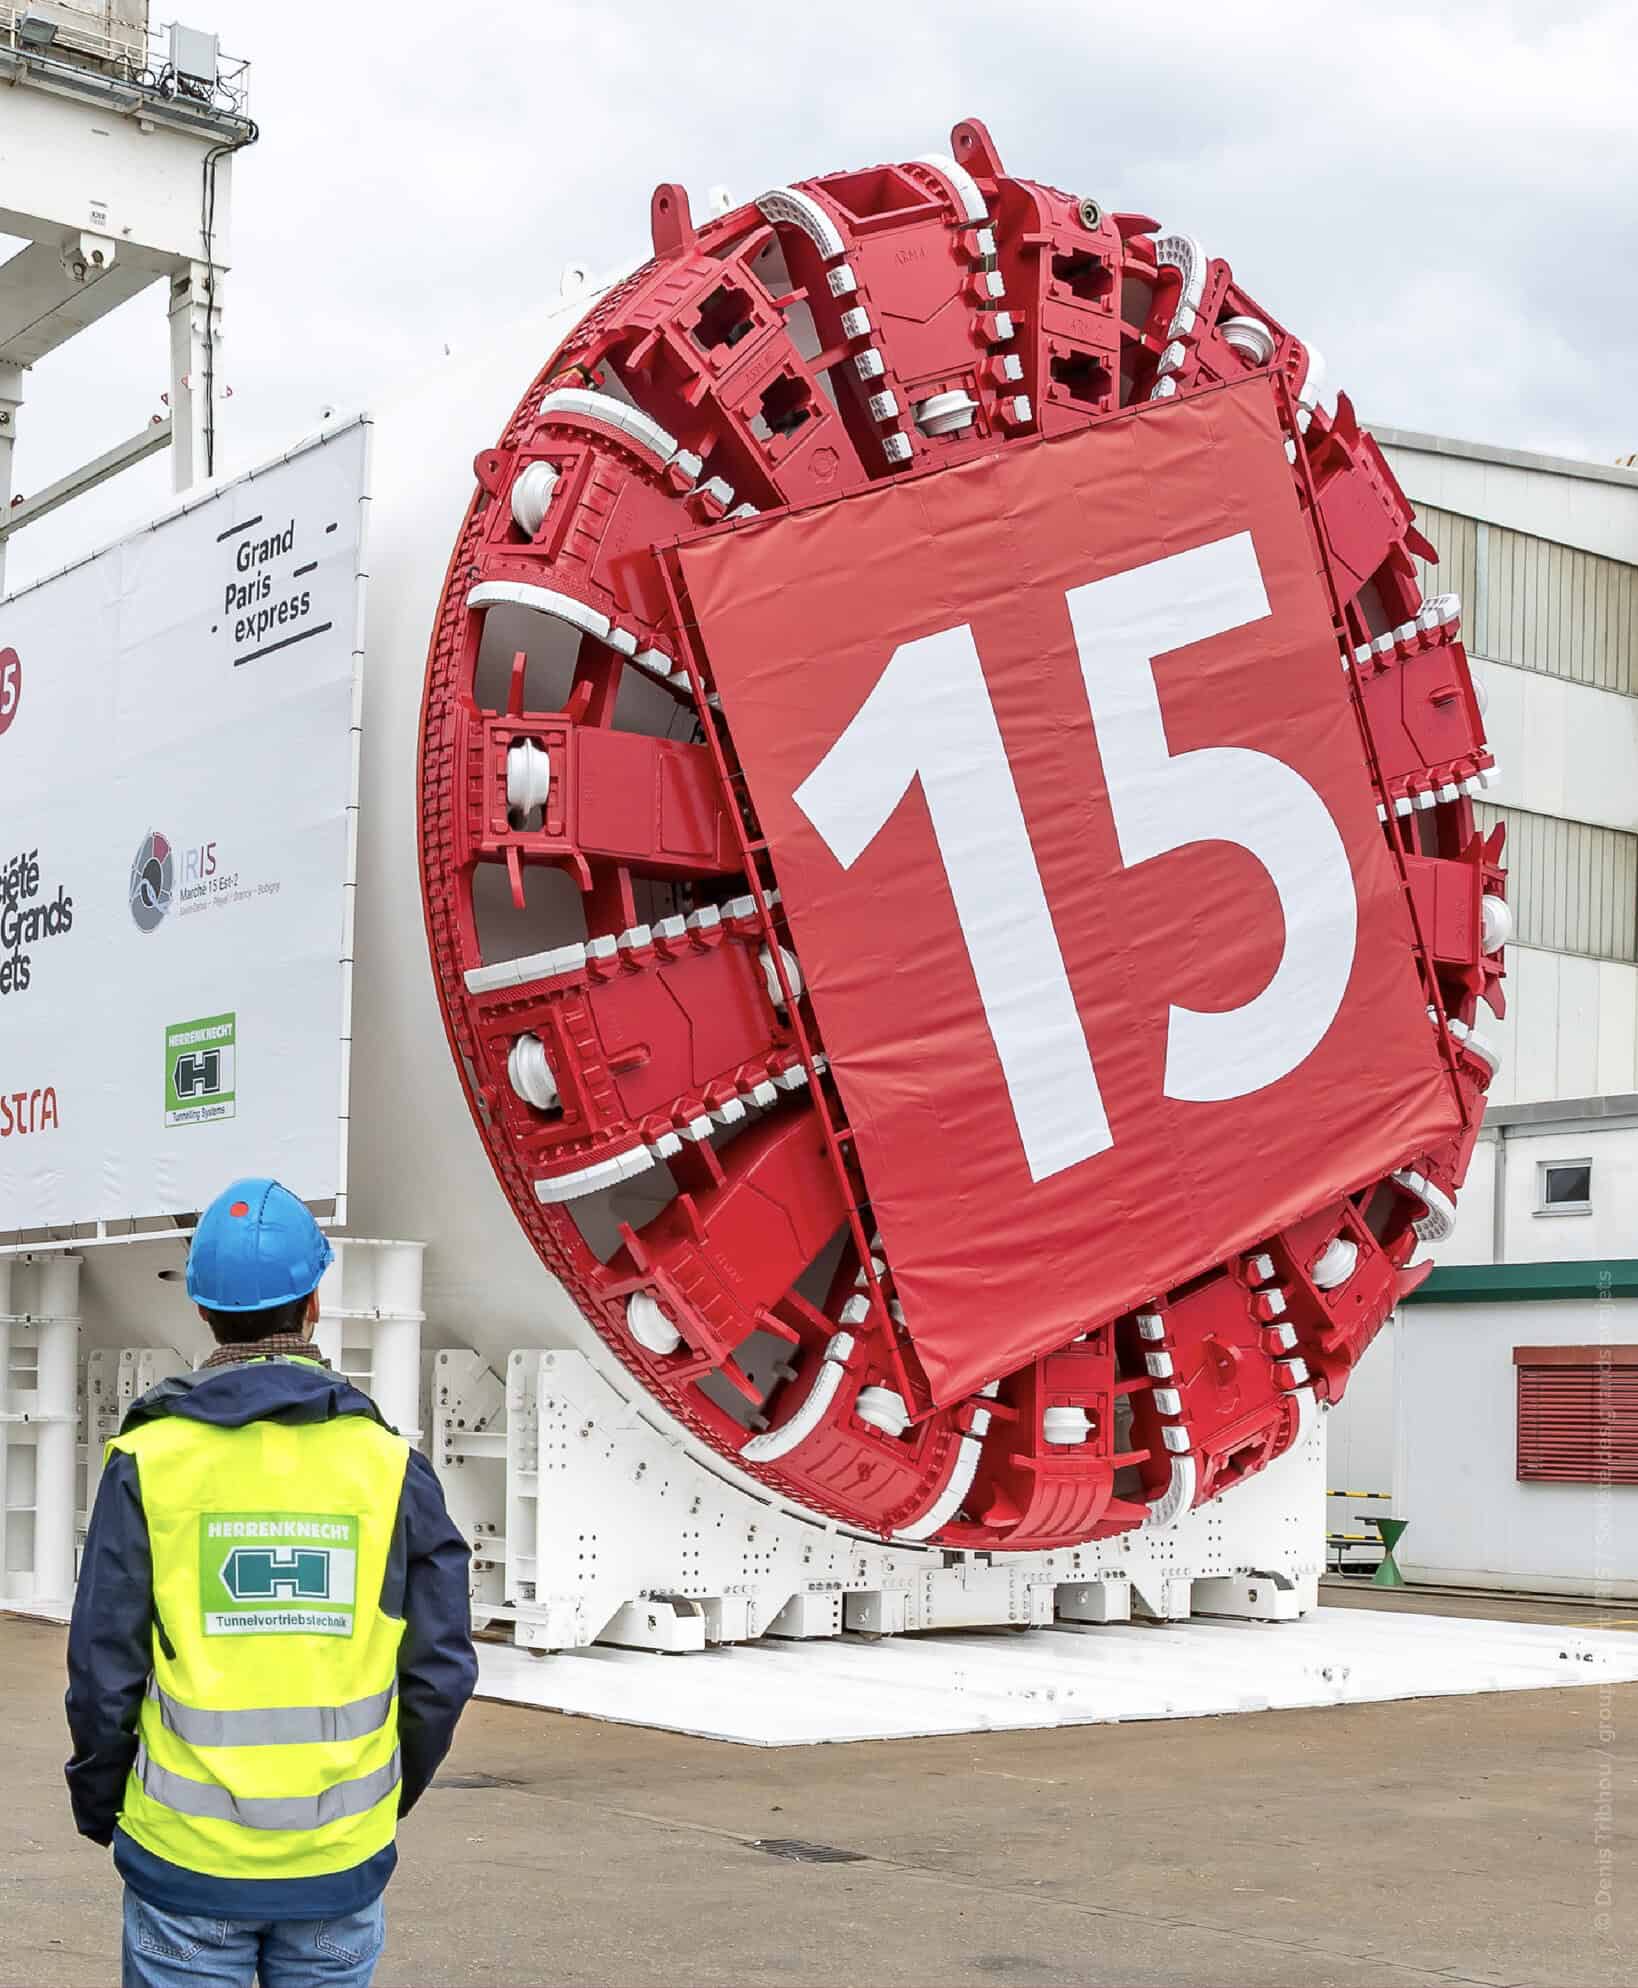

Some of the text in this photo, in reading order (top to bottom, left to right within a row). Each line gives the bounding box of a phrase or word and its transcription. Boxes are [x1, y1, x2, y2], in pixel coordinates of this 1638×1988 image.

[236, 519, 295, 572] Grand
[225, 570, 271, 614] Paris
[234, 592, 310, 642] express
[0, 663, 16, 714] 5
[0, 848, 39, 904] iété
[791, 530, 1358, 1183] 15
[1, 885, 72, 949] Grands
[168, 1023, 233, 1048] HERRENKNECHT
[208, 1520, 349, 1540] HERRENKNECHT
[216, 1614, 346, 1628] Tunnelvortriebstechnik
